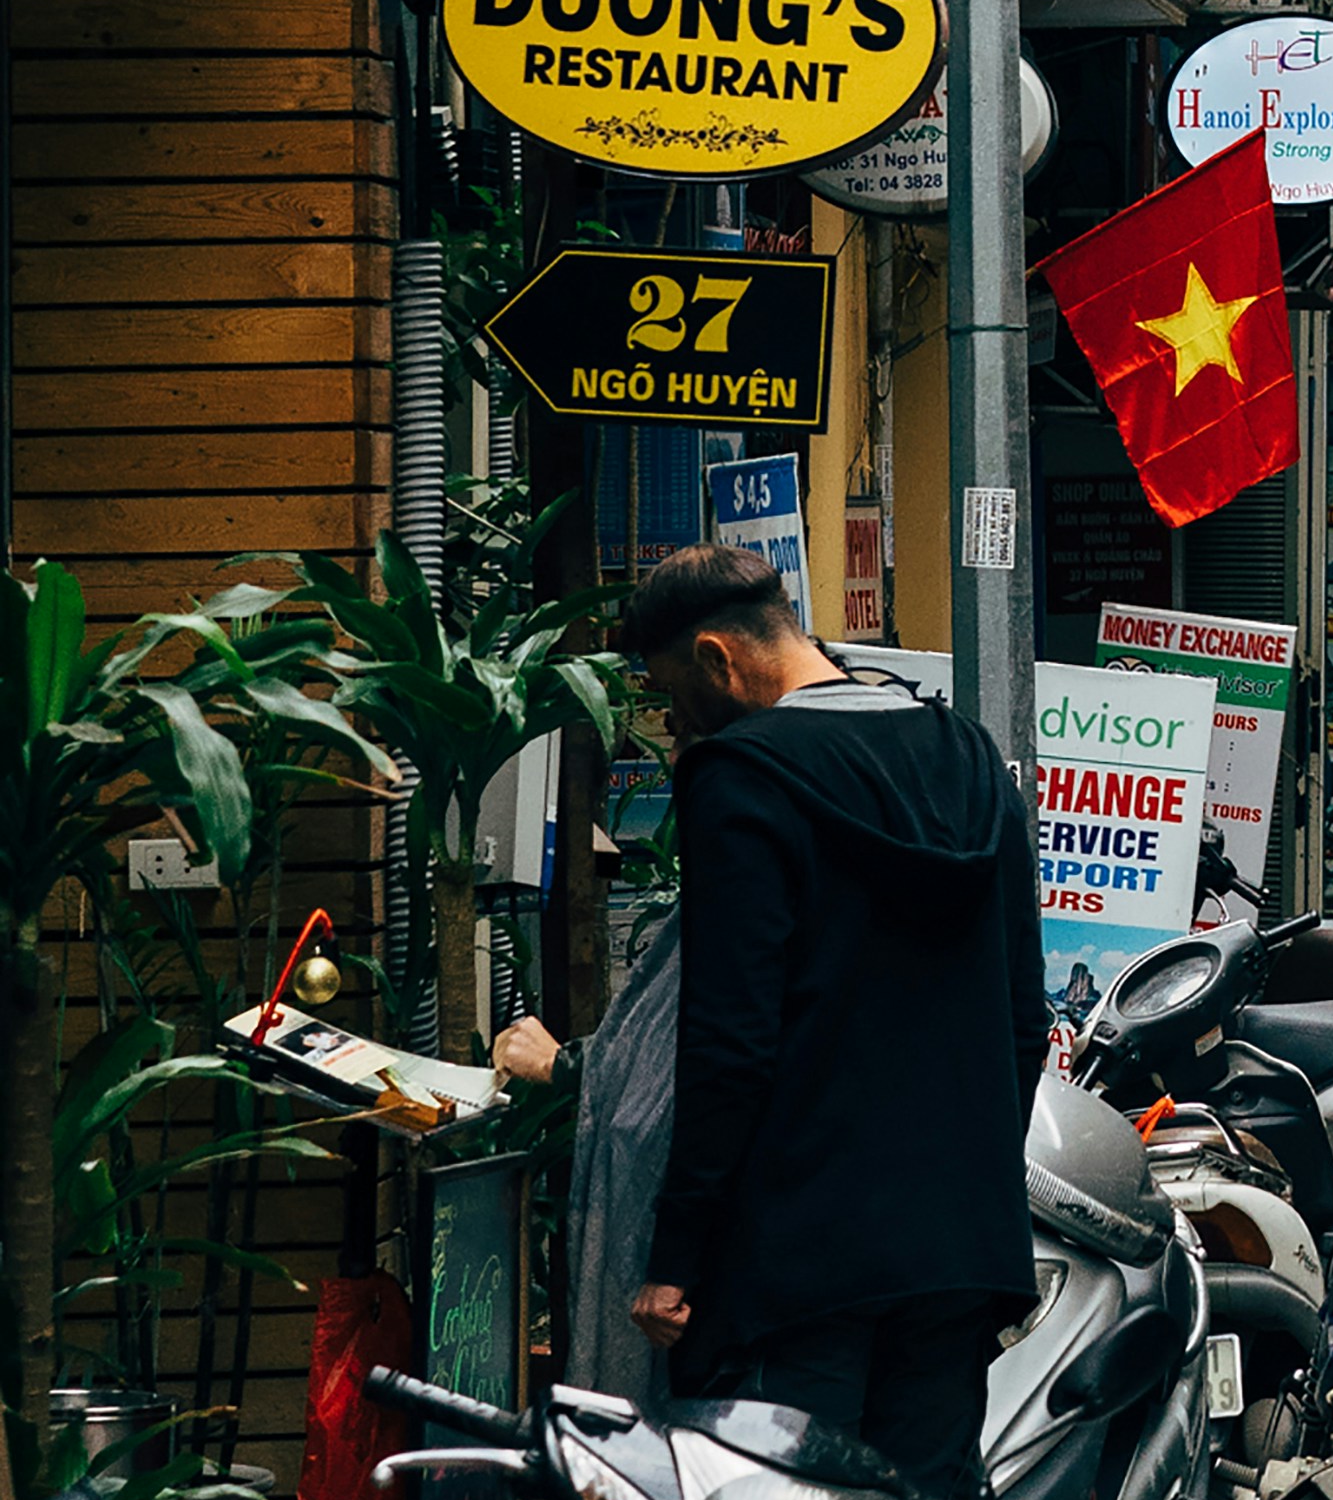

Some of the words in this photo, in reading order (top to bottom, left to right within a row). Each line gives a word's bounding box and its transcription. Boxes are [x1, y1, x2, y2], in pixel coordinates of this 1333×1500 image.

[522, 43, 849, 104] RESTAURANT
[1175, 88, 1251, 129] Hanoi
[859, 153, 879, 169] 31
[884, 152, 919, 170] Ngo
[1271, 141, 1332, 162] Strong
[844, 178, 876, 193] Tel:
[879, 176, 899, 192] 04
[906, 173, 944, 190] 3828
[1271, 182, 1301, 202] Ngo
[625, 273, 754, 356] 27
[571, 366, 655, 403] NGÕ
[665, 367, 798, 418] HUYỆN
[733, 473, 744, 516] $
[747, 472, 772, 514] 4,5
[1101, 614, 1177, 650] MONEY
[1178, 625, 1289, 664] EXCHANGE
[1039, 696, 1185, 749] dvisor
[1211, 802, 1262, 824] TOURS
